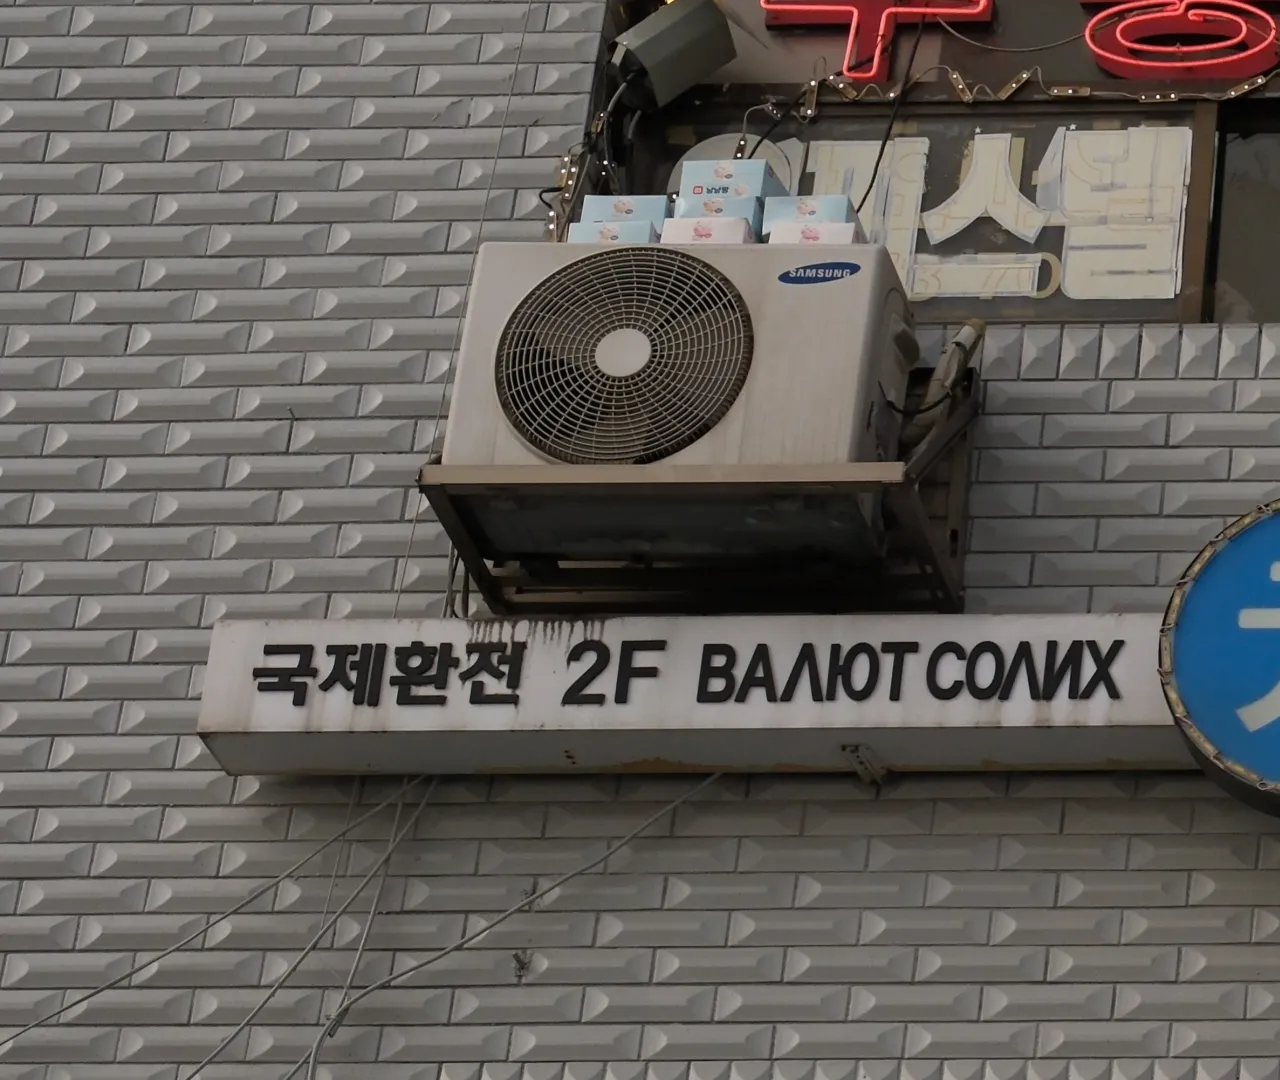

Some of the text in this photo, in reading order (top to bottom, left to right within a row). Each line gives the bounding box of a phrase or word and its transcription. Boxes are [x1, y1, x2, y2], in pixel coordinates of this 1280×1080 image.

[788, 267, 851, 279] SAMSUNG
[251, 640, 528, 707] 국제환전
[560, 638, 668, 706] 2F
